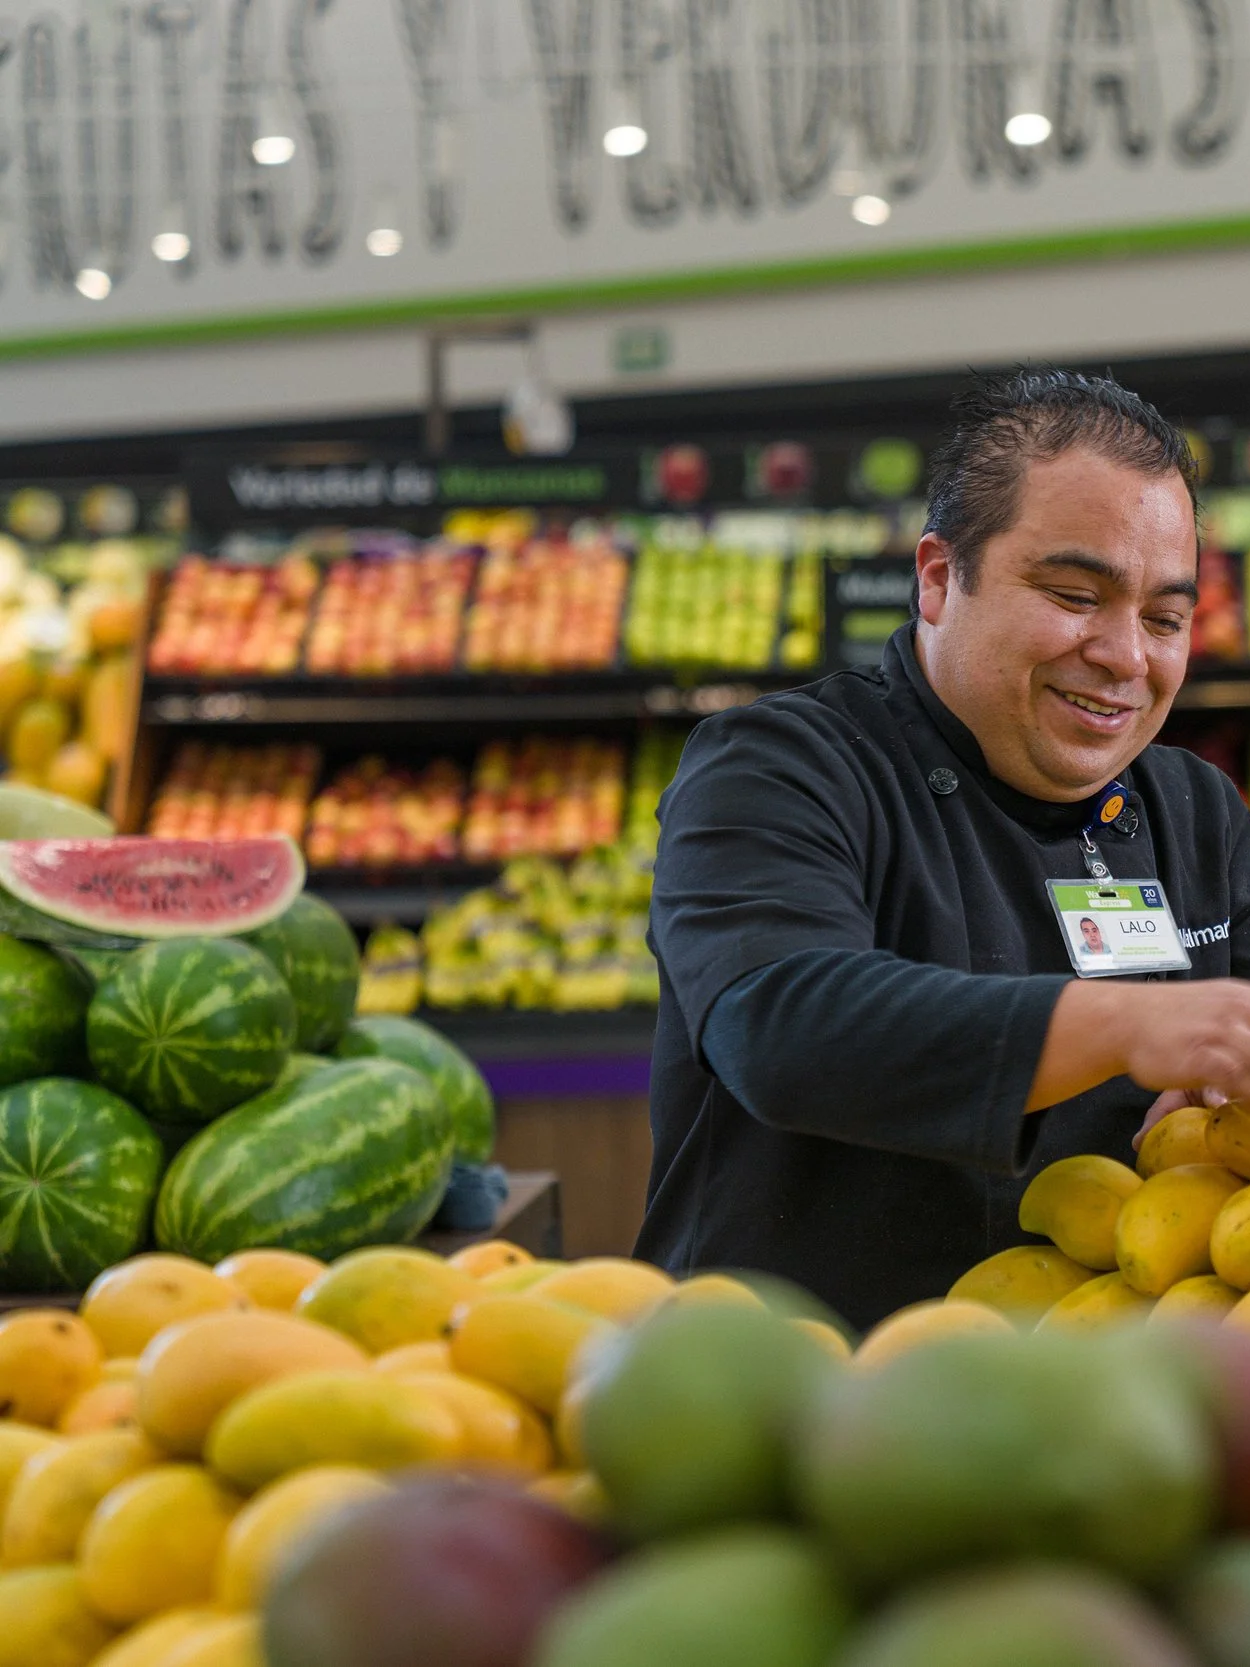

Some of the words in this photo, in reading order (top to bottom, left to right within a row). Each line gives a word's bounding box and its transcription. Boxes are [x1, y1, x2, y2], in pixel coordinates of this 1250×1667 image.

[0, 0, 345, 288] RUTAS
[1144, 888, 1156, 898] 20
[1119, 920, 1157, 934] LALO
